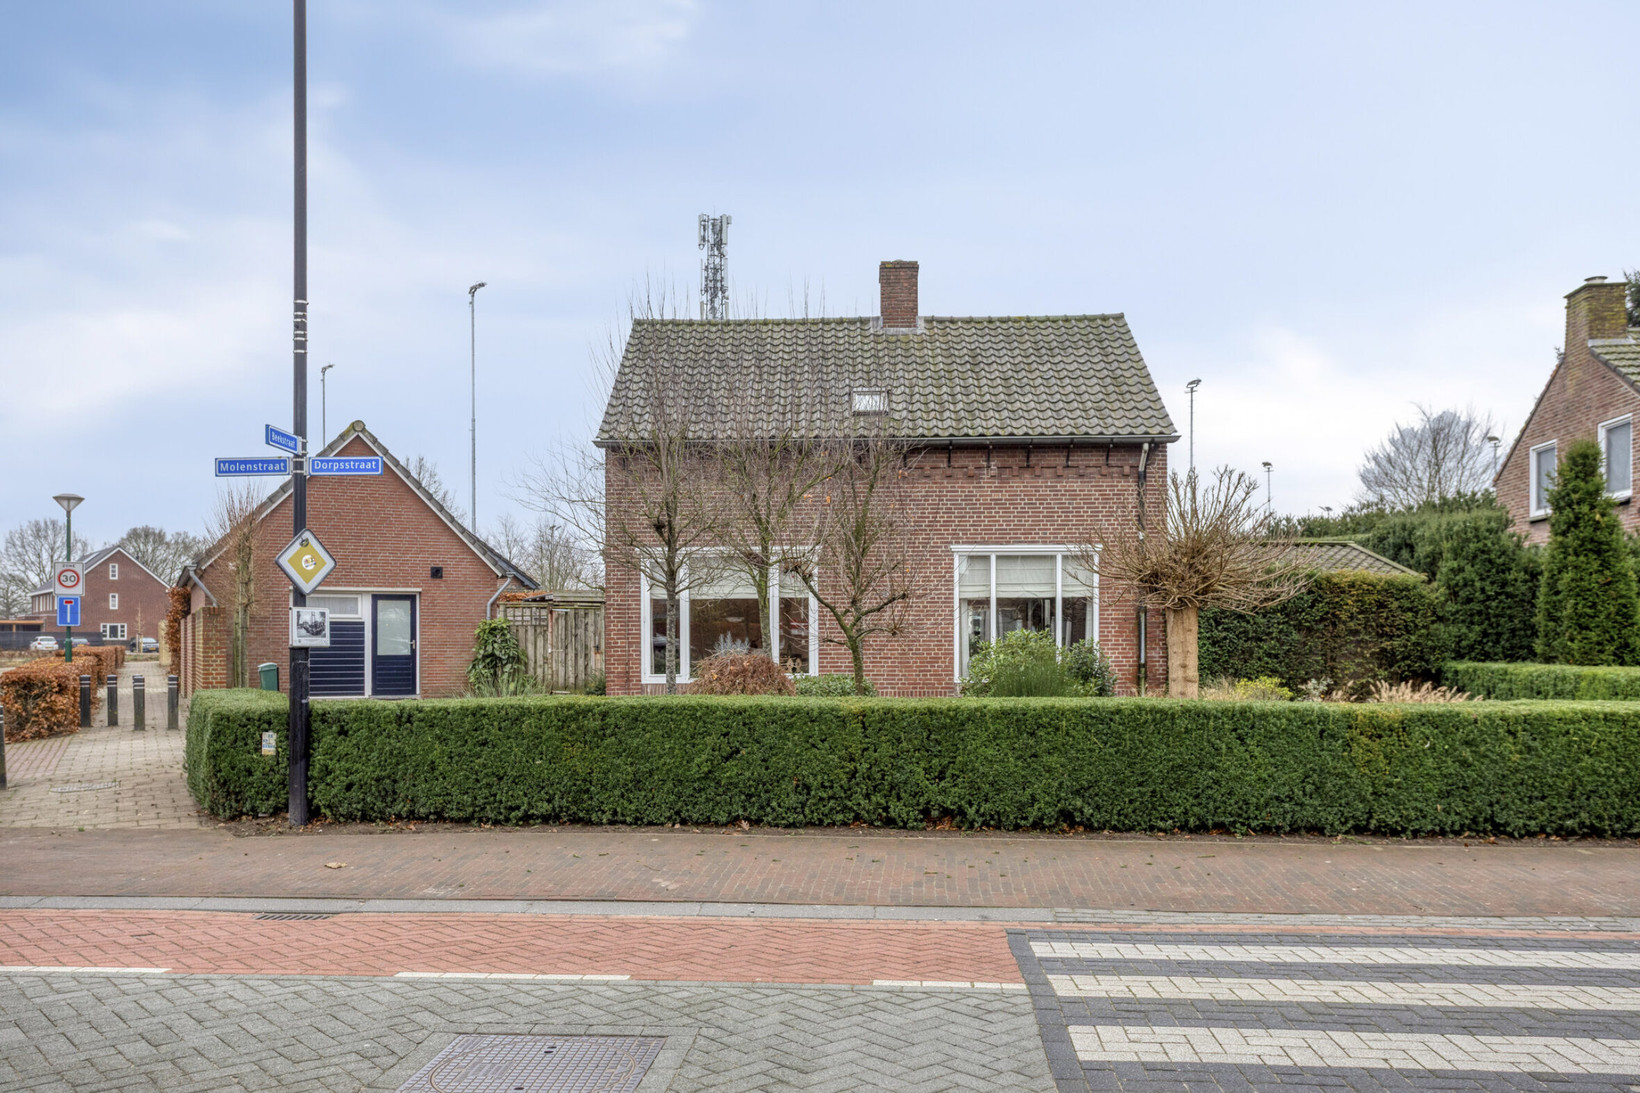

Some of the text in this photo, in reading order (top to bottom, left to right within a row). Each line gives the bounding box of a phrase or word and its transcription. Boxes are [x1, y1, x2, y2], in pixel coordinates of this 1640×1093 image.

[271, 431, 296, 449] Beekstraat
[220, 461, 286, 472] Molenstraat
[314, 460, 377, 471] Dorpsstraat
[62, 574, 76, 583] 30
